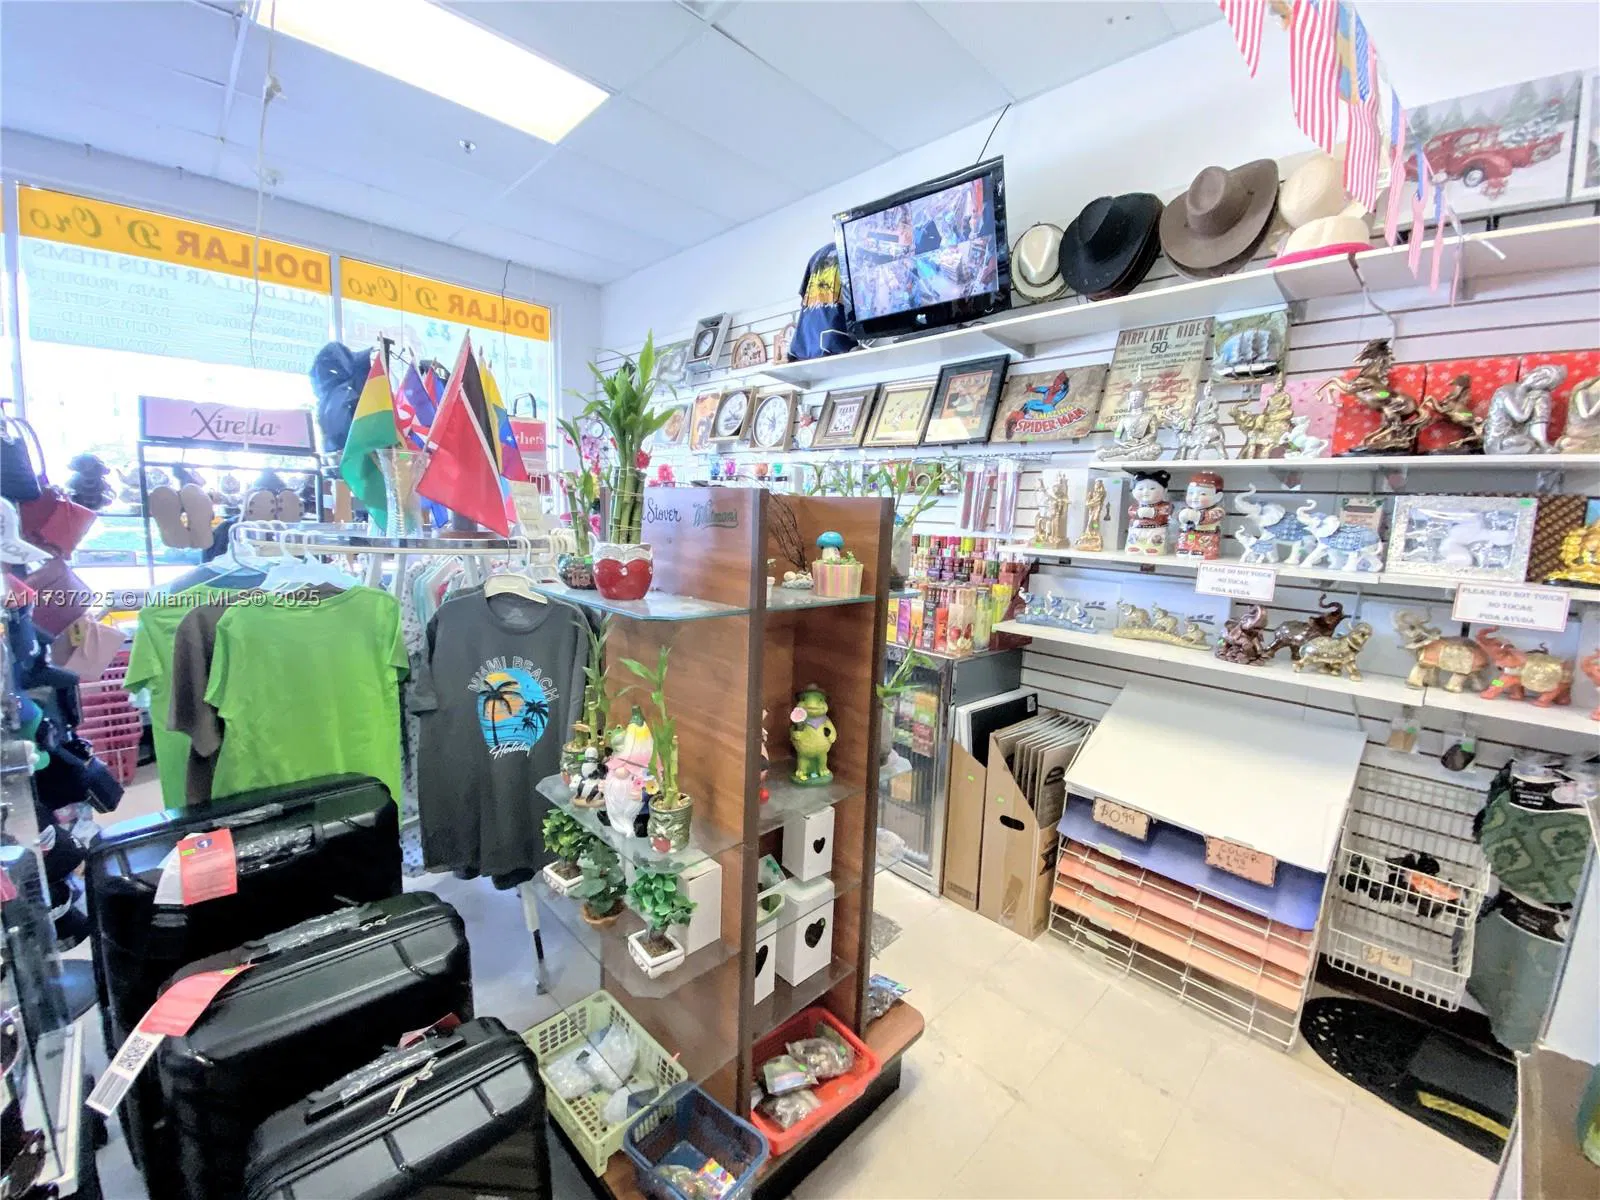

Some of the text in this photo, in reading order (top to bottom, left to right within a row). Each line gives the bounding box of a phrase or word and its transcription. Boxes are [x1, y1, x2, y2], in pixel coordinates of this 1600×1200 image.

[1120, 319, 1211, 346] AIRPLANE RIDES
[191, 406, 276, 441] Xirella
[647, 497, 682, 524] Stover
[467, 655, 560, 702] MIAMI BEACH
[489, 740, 532, 761] Holiday
